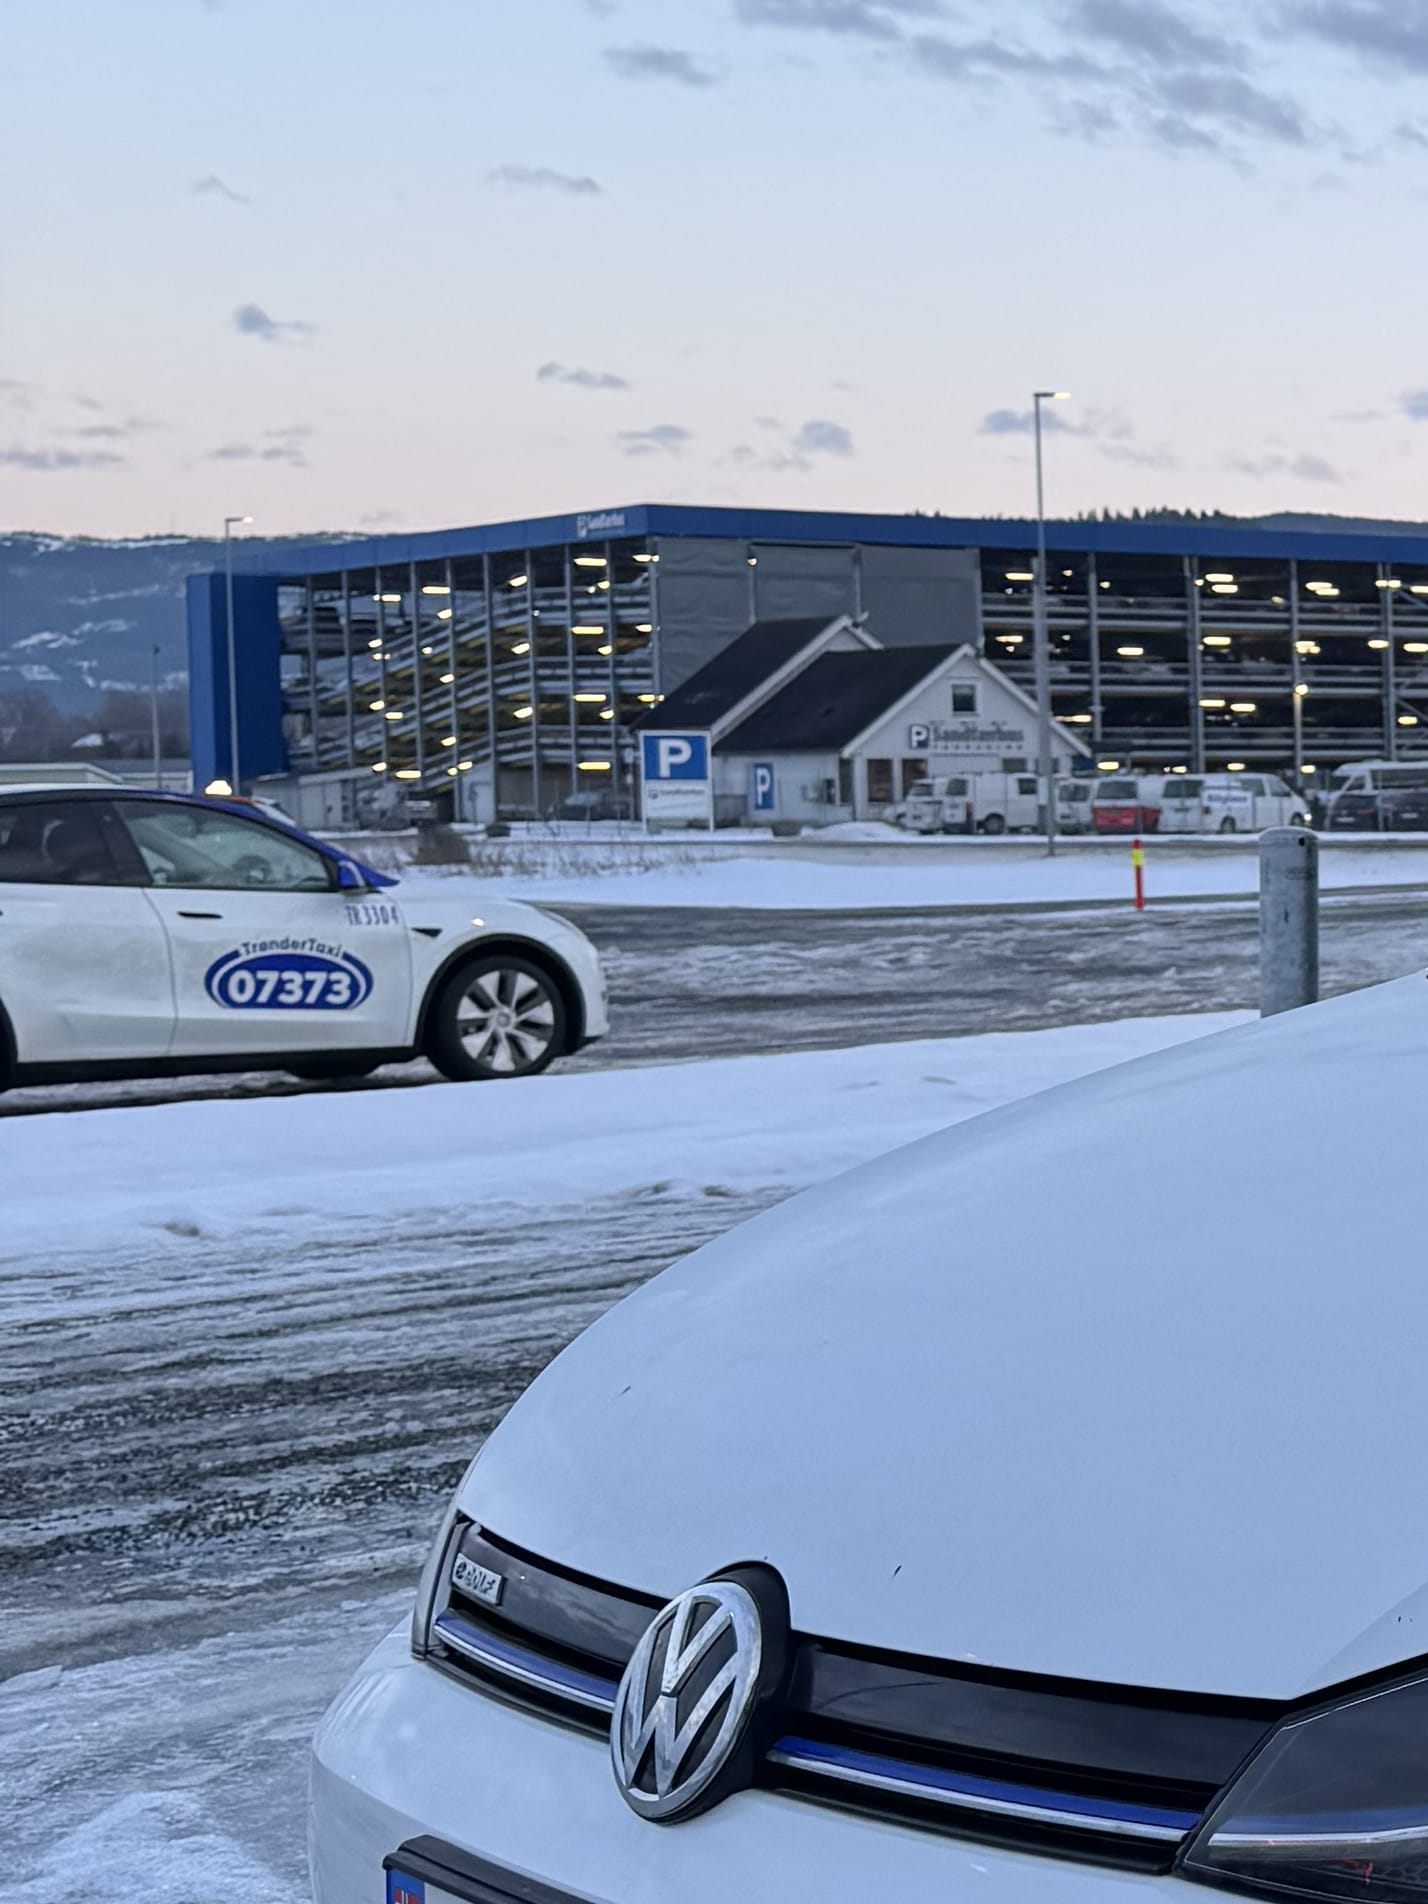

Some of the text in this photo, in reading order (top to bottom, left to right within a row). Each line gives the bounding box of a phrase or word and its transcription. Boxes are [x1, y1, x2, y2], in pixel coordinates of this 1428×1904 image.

[658, 738, 692, 778] P
[756, 767, 771, 806] P
[227, 969, 352, 1005] 07373
